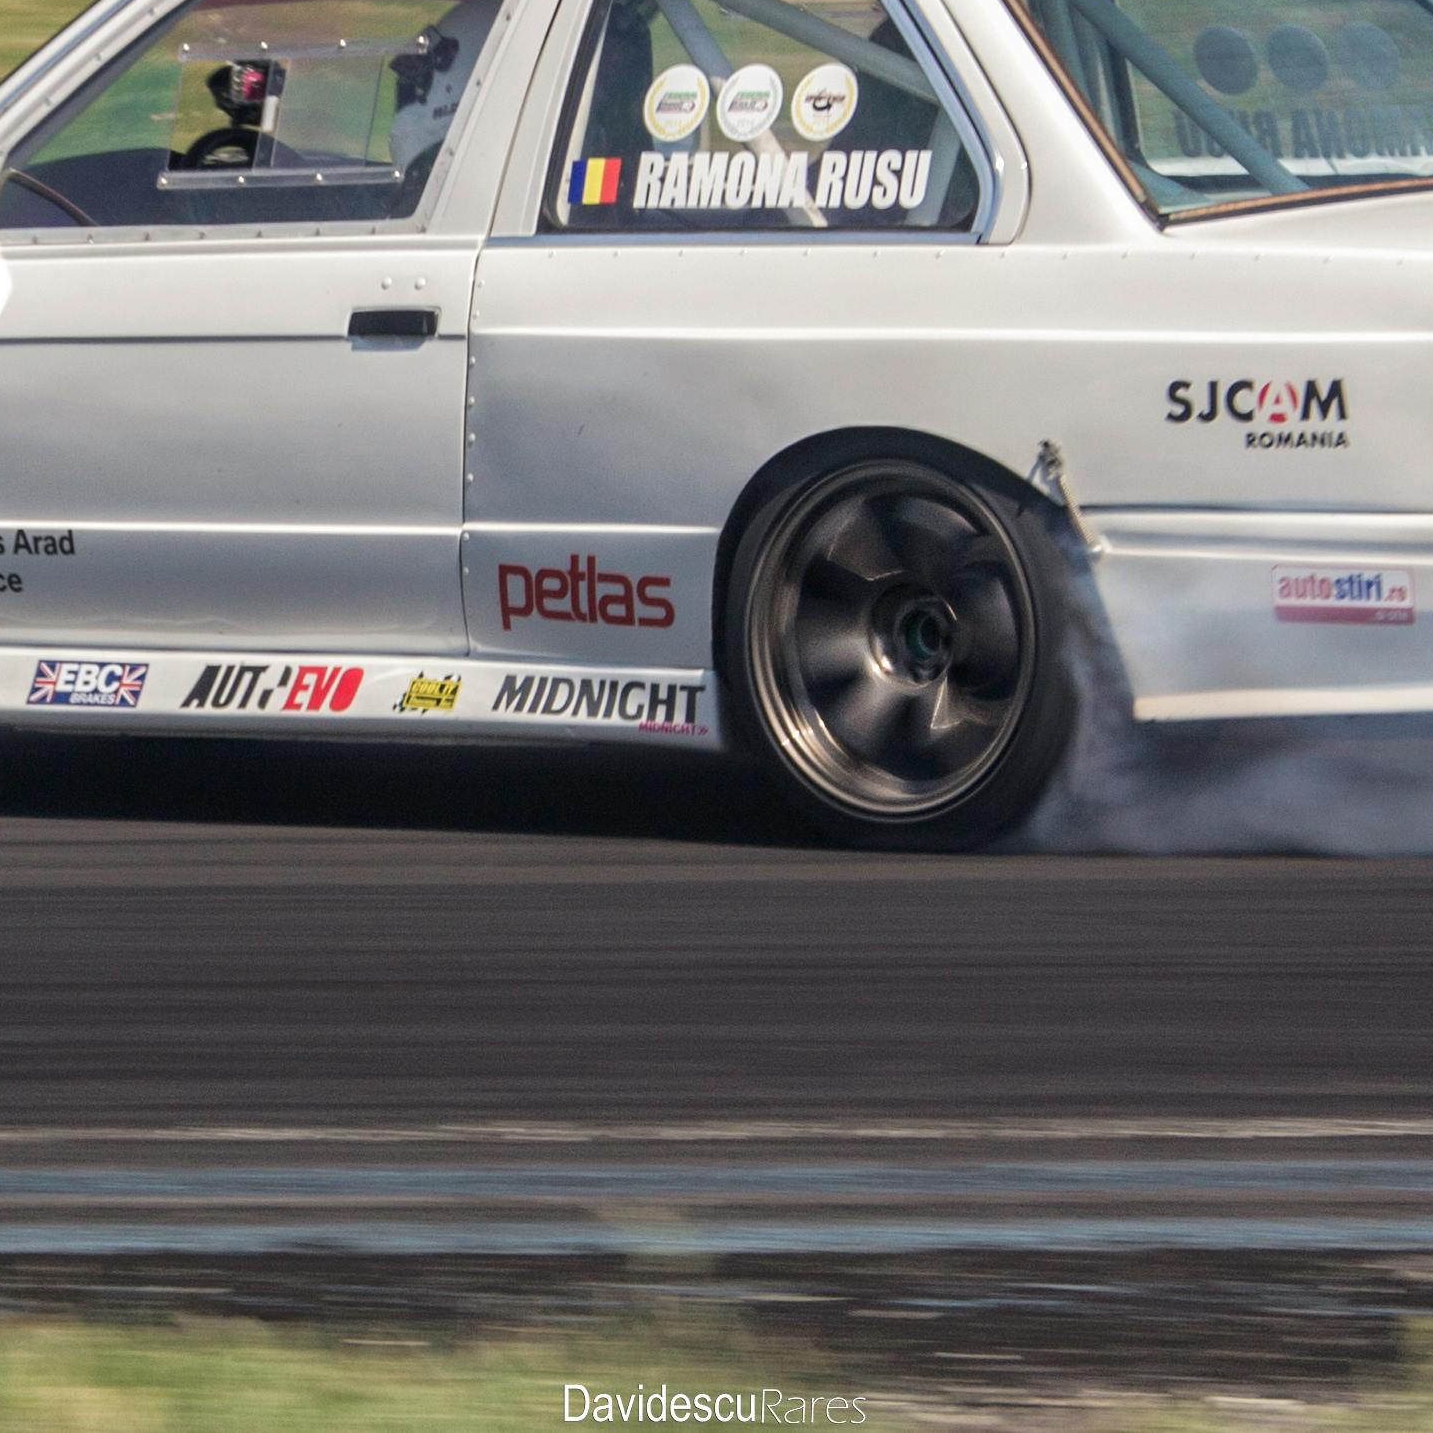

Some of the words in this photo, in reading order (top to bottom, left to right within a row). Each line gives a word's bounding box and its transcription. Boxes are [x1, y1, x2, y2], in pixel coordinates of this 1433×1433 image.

[633, 151, 808, 209] RAMONA
[815, 149, 932, 209] RUSU
[1165, 379, 1349, 423] SJCAM
[1246, 431, 1350, 449] ROMANIA
[13, 529, 75, 556] Arad
[498, 553, 675, 631] petlas
[55, 663, 124, 694] EBC
[69, 692, 116, 705] BRAKES
[492, 675, 706, 725] MIDNIGHT
